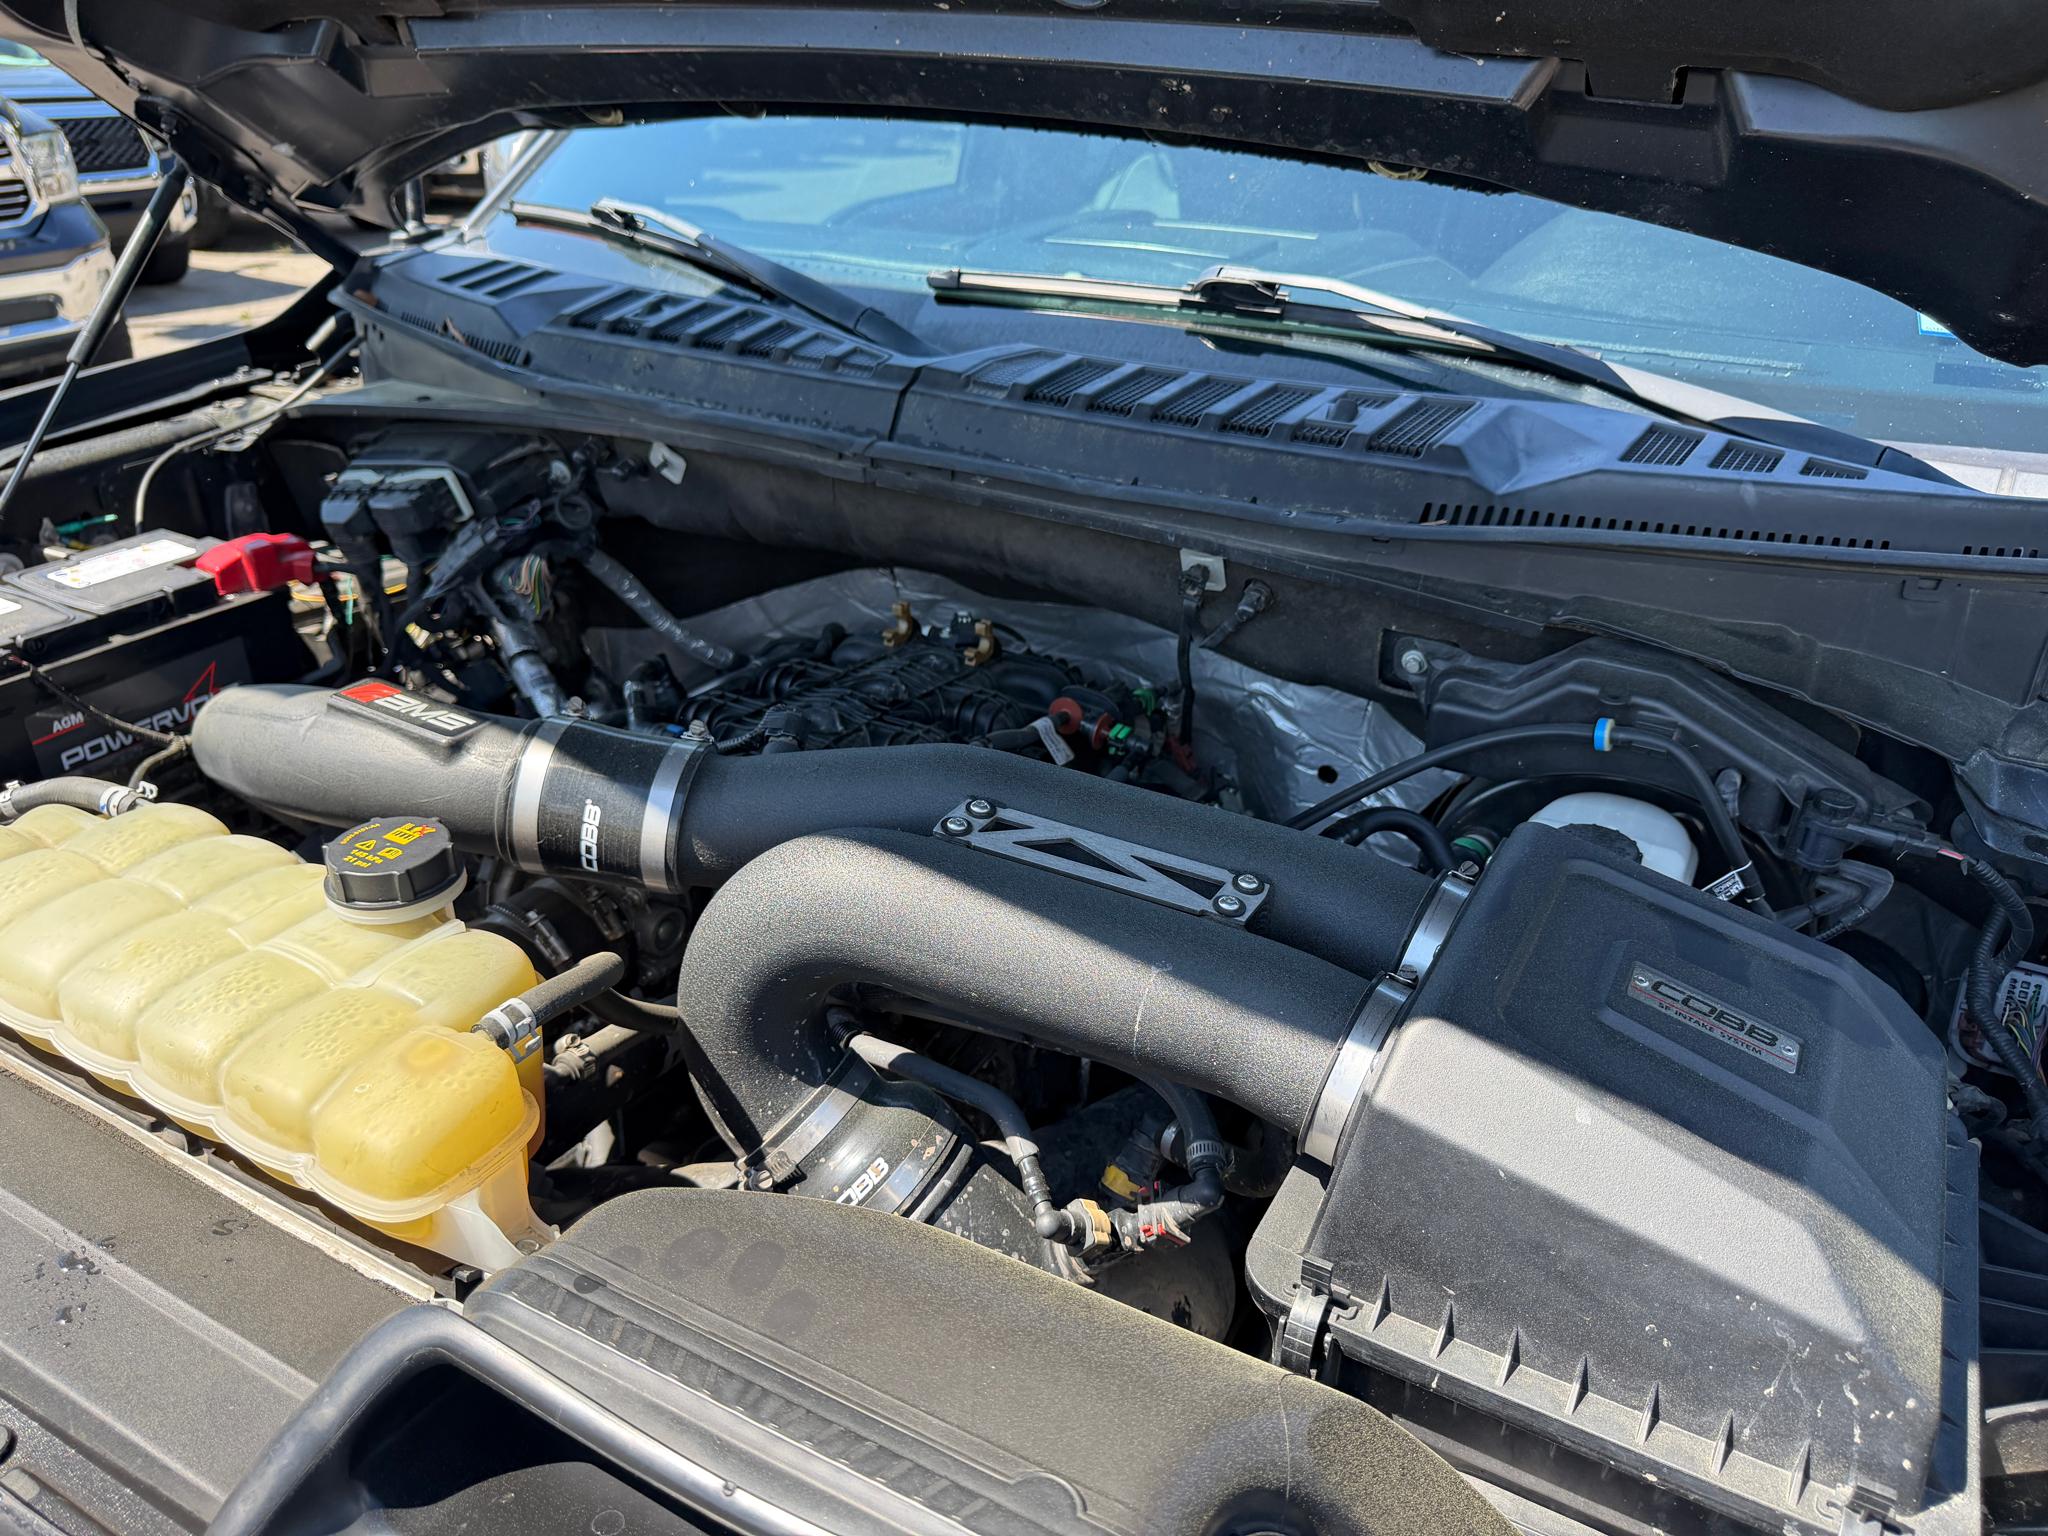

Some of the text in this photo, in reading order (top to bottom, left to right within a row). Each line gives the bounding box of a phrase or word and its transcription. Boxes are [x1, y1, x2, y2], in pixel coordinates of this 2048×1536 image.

[53, 711, 84, 733] AGM
[579, 803, 601, 872] COBB
[1651, 980, 1779, 1048] COBB
[1674, 1010, 1715, 1033] INTAKE
[1719, 1030, 1762, 1056] SYSTEM
[835, 1157, 889, 1206] OBB
